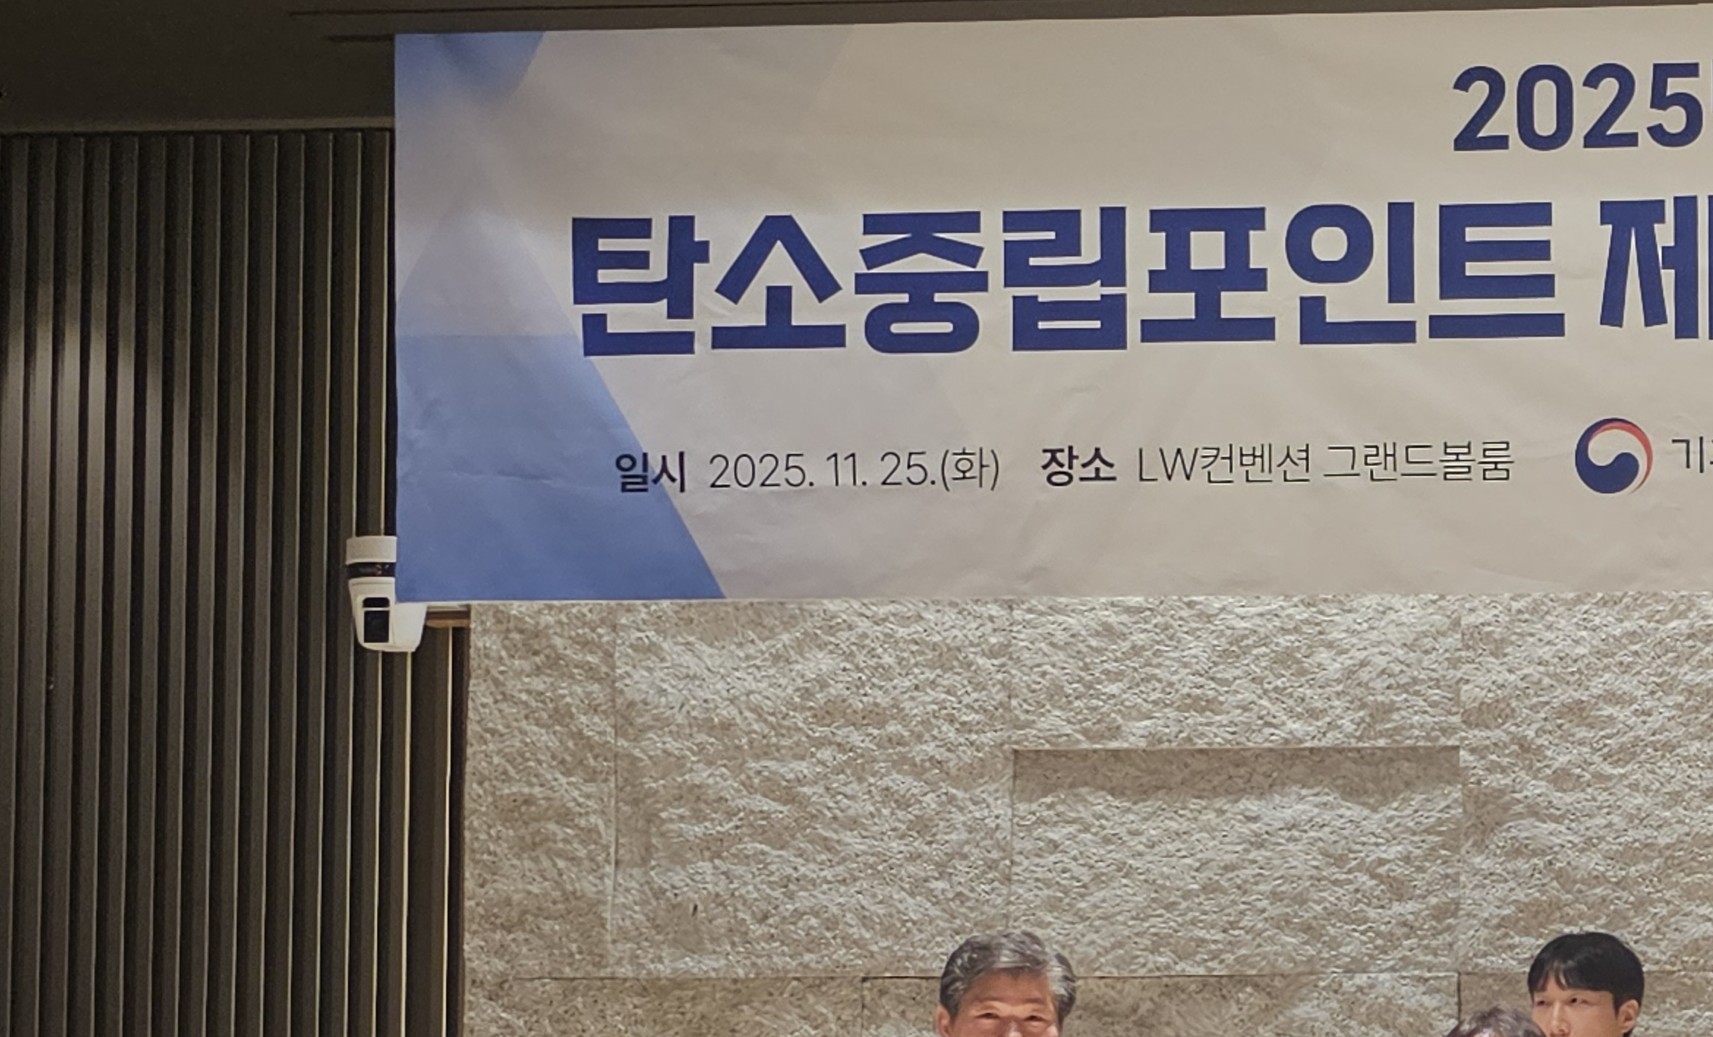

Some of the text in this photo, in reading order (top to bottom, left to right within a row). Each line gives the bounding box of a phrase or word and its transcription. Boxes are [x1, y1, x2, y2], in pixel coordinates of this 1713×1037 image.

[572, 201, 1565, 357] 탄소중립포인트
[615, 441, 1515, 493] 일시 2025. 11. 25.(화) 장소 LW컨벤션 그랜드볼룸
